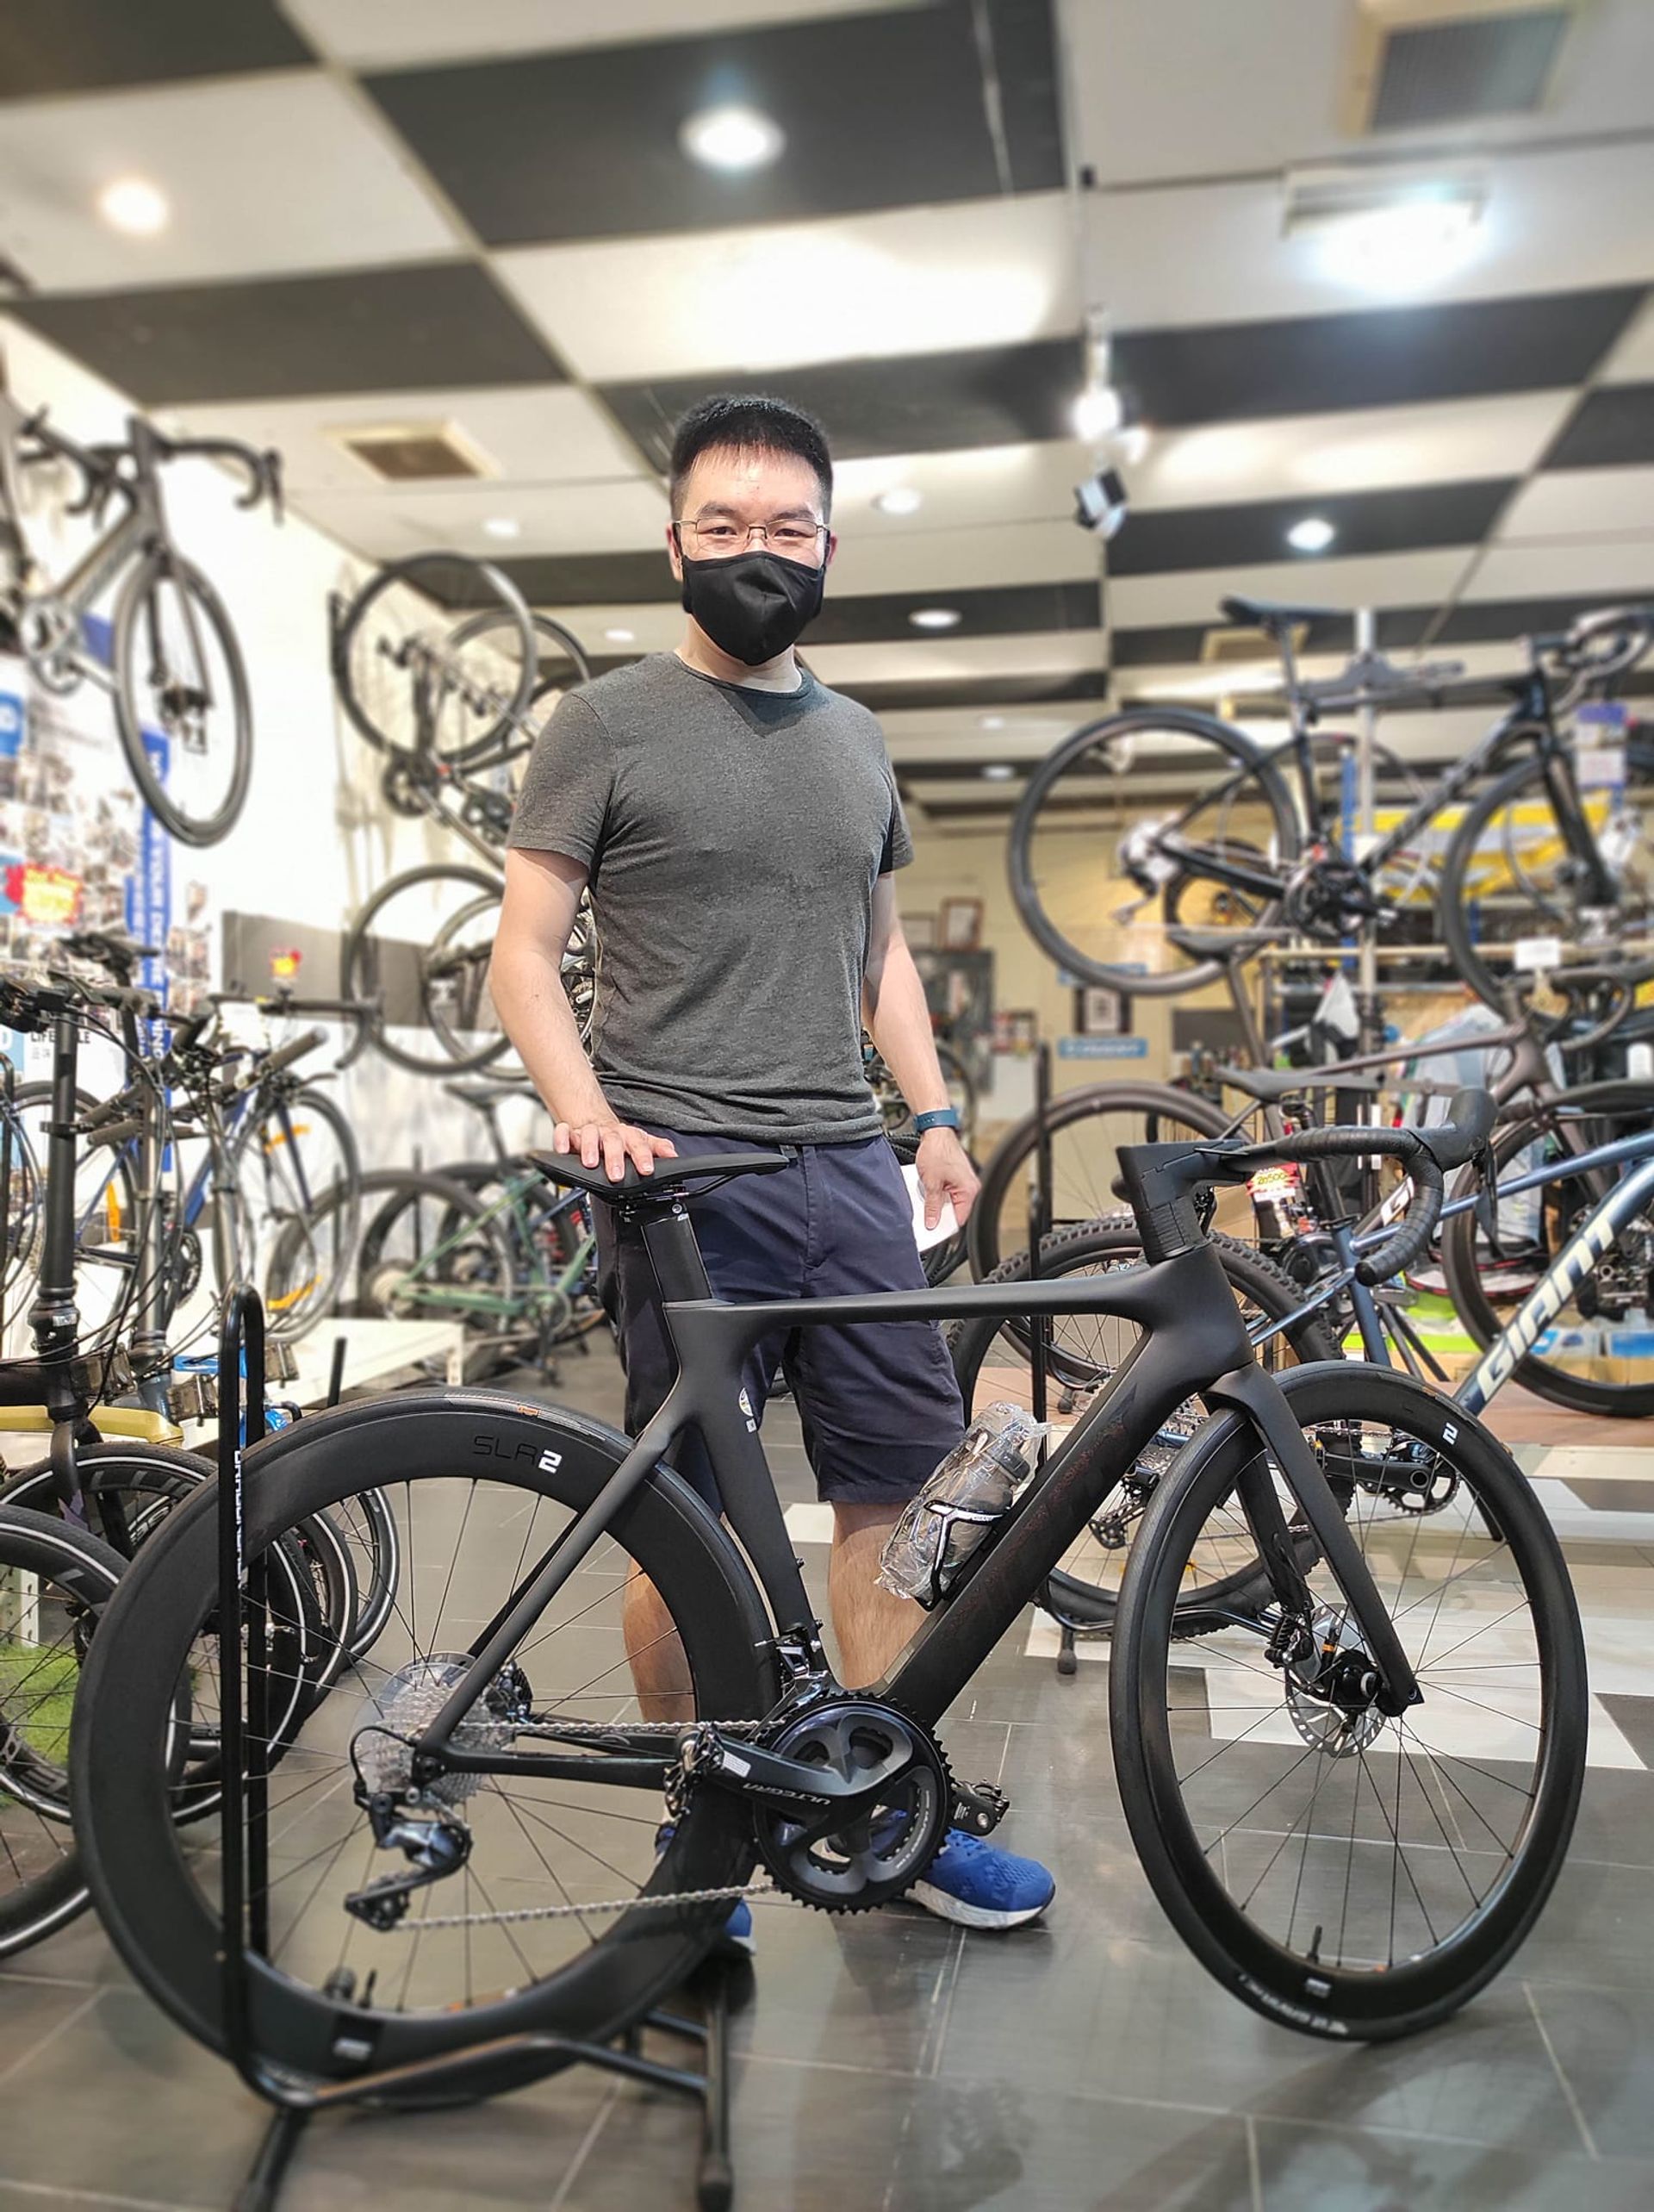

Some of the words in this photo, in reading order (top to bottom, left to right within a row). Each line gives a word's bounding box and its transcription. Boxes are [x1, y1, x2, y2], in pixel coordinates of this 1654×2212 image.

[30, 1031, 90, 1044] LIFELE
[1477, 1196, 1617, 1401] GIANT
[743, 1782, 831, 1805] ULTEGRA
